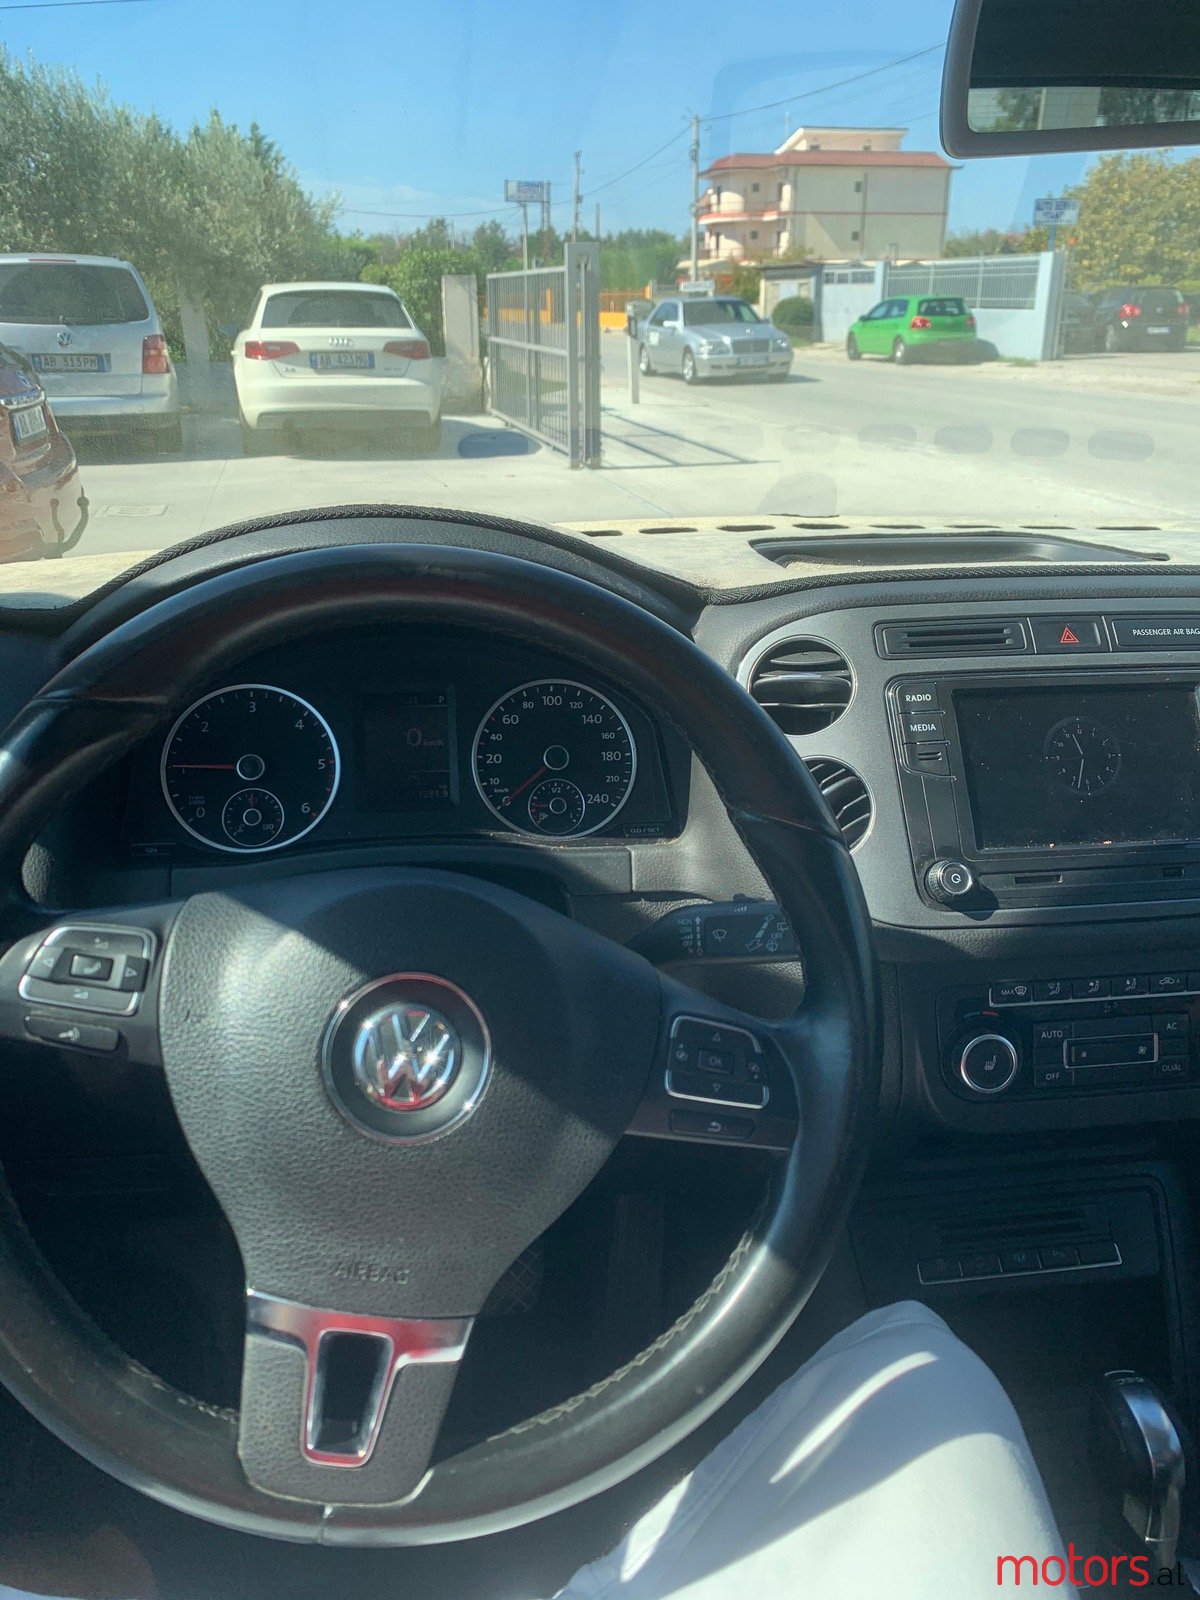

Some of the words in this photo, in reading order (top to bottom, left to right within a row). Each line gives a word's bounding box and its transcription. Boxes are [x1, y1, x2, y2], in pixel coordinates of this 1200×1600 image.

[1132, 628, 1171, 636] PASSENGER
[542, 695, 563, 706] 100
[905, 694, 932, 702] RADIO
[249, 702, 257, 712] 3
[522, 701, 534, 709] 80
[569, 701, 583, 709] 120
[502, 714, 519, 725] 60
[582, 714, 602, 724] 140
[201, 722, 209, 732] 2
[295, 719, 304, 730] 4
[910, 723, 937, 731] MEDIA
[490, 733, 502, 741] 40
[486, 753, 502, 764] 20
[601, 751, 621, 761] 180
[318, 758, 326, 769] 5
[489, 777, 500, 785] 10
[587, 793, 609, 804] 240
[196, 807, 205, 818] 0
[301, 802, 310, 813] 6
[1001, 988, 1015, 996] MAX
[1166, 1022, 1178, 1031] AC
[1041, 1029, 1063, 1039] AUTO
[1045, 1072, 1061, 1081] OFF
